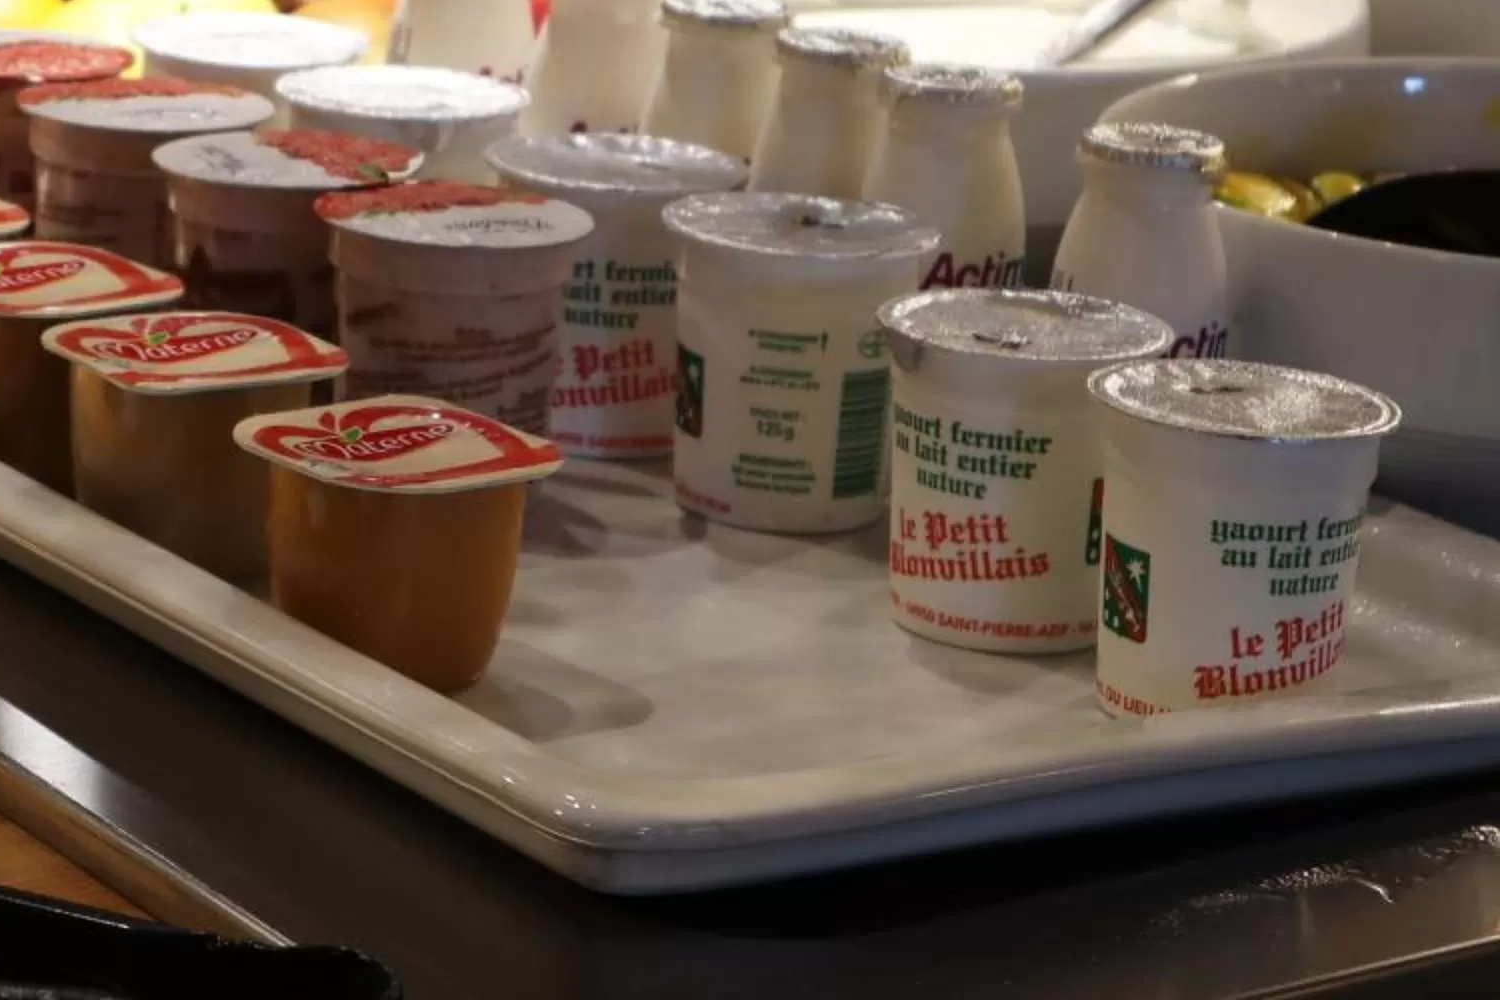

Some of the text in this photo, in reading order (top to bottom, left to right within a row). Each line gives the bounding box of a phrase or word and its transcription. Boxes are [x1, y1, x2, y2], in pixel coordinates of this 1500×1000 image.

[93, 327, 258, 363] Materne
[296, 421, 455, 461] Materne
[951, 421, 1053, 456] fermier
[916, 434, 948, 467] lait
[957, 453, 1038, 480] entier
[917, 467, 988, 500] nature
[923, 509, 1011, 550] Petit
[1210, 519, 1309, 543] yaourt
[1221, 549, 1257, 568] au
[1267, 545, 1311, 569] lait
[1268, 571, 1339, 596] nature
[1229, 599, 1345, 661] le Petit
